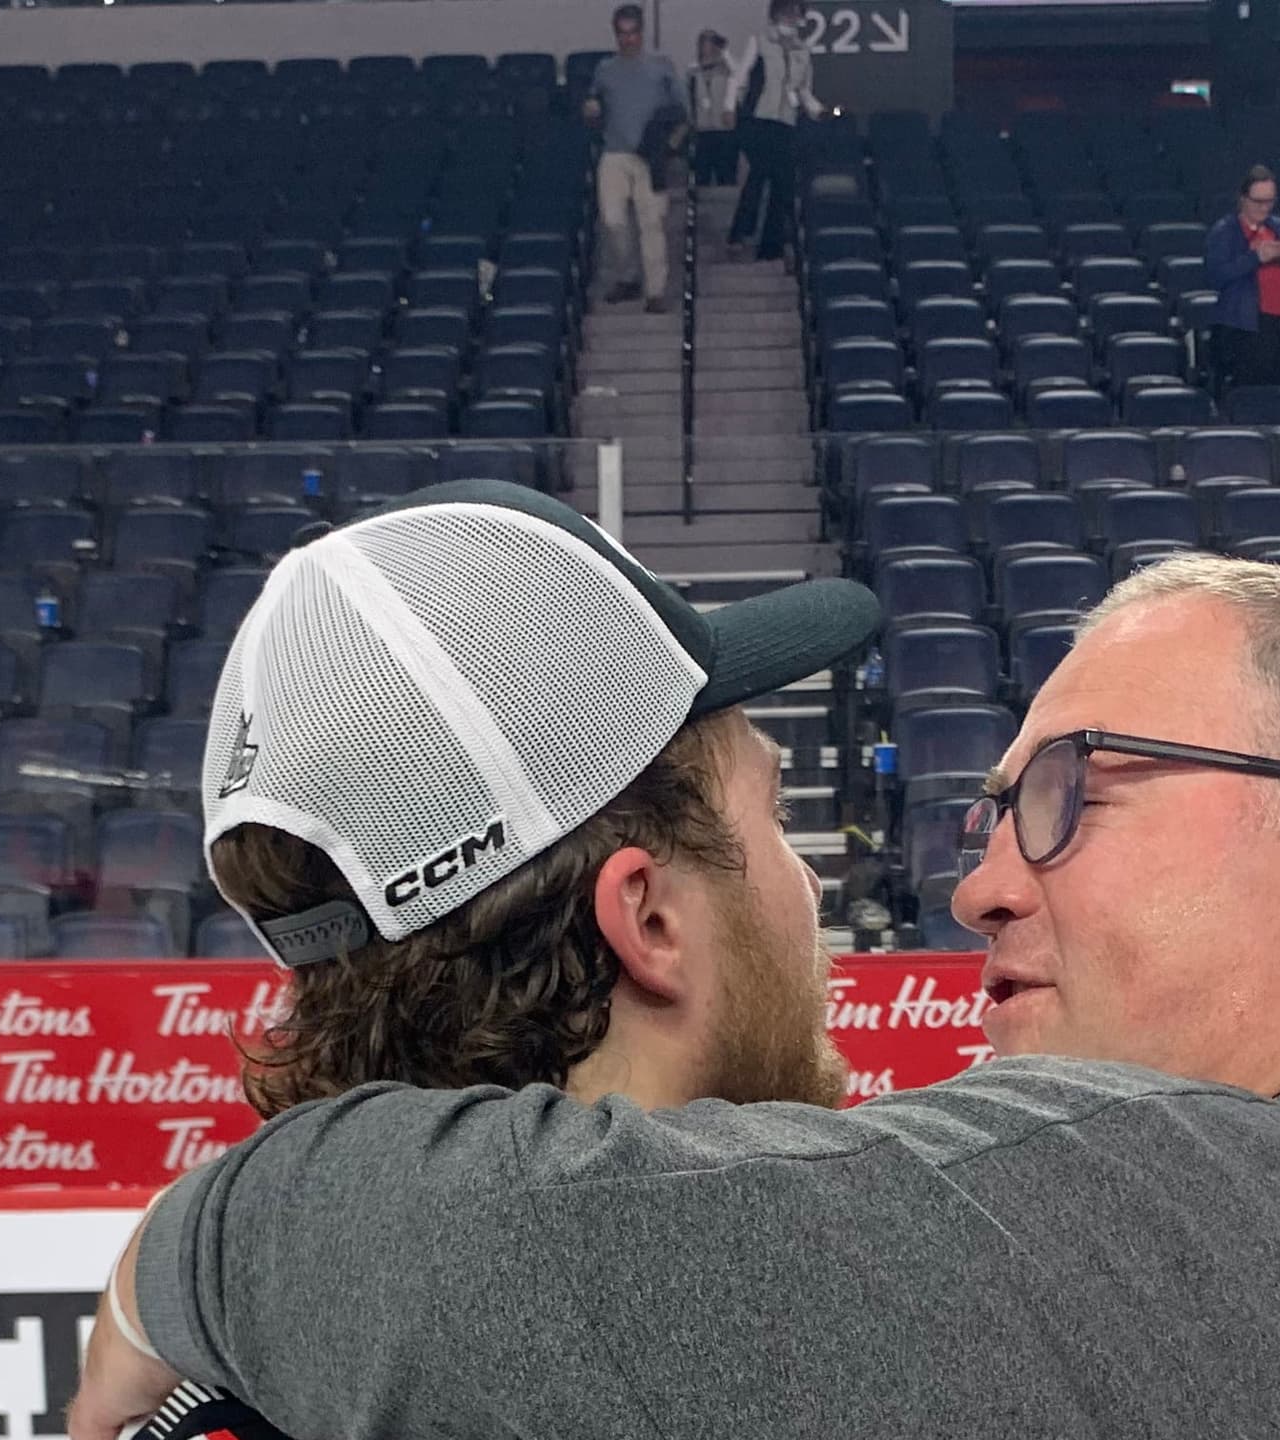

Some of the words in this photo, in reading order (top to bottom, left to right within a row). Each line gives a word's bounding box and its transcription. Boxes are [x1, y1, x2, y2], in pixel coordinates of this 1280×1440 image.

[805, 9, 860, 54] 22
[384, 820, 506, 908] CCM
[153, 983, 236, 1036] Tim
